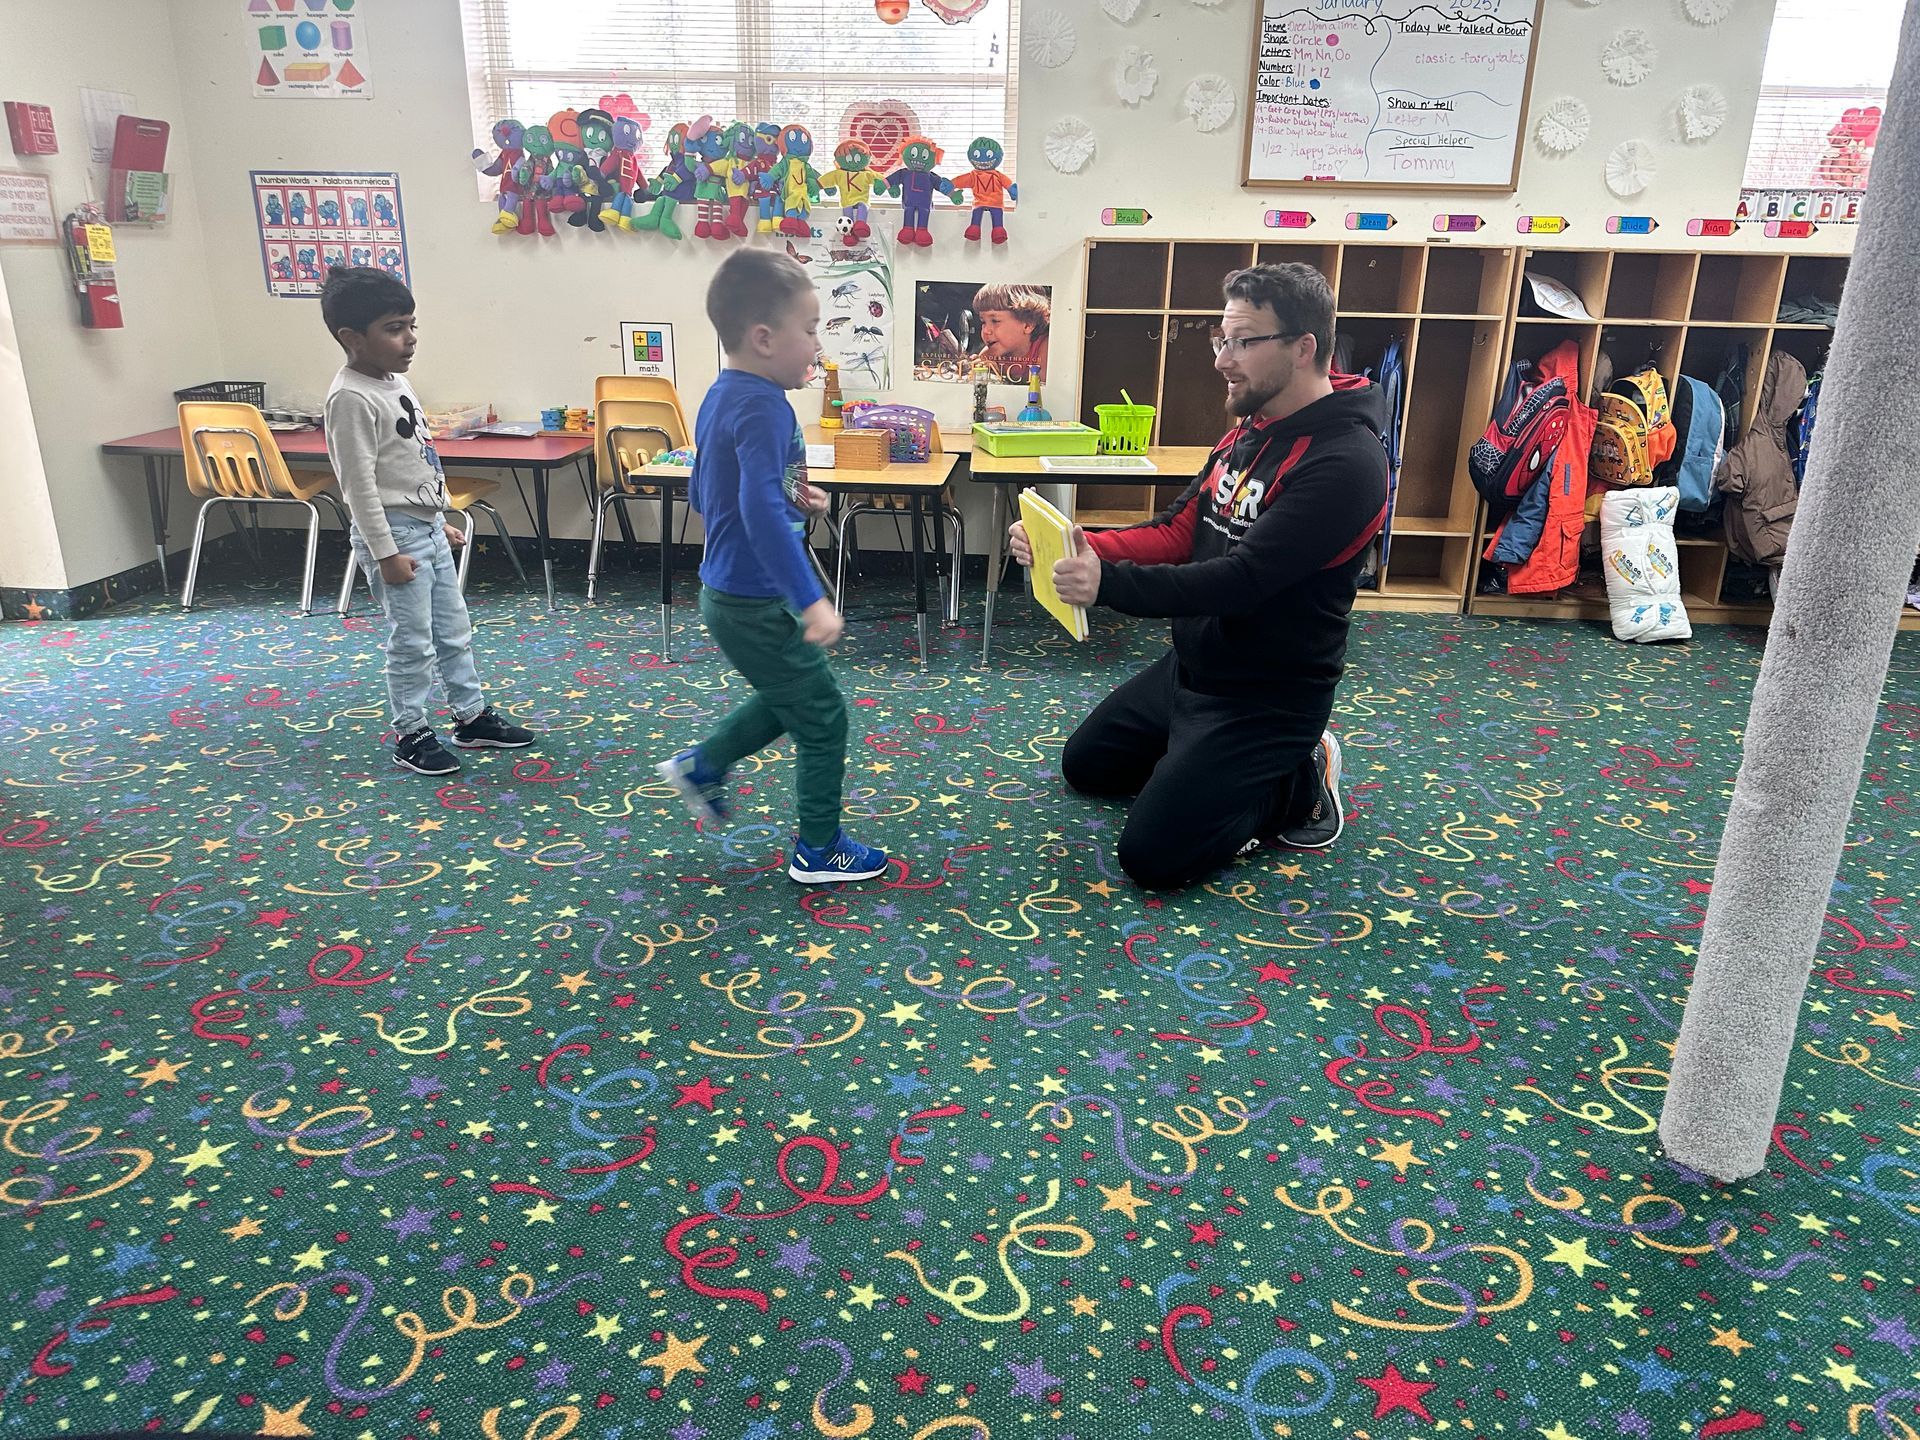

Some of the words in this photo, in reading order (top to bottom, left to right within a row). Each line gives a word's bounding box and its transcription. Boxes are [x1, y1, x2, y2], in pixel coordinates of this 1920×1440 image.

[1399, 21, 1430, 35] Today
[1437, 24, 1451, 32] we
[1457, 22, 1494, 34] talked
[1497, 25, 1528, 36] about
[1292, 34, 1323, 46] Circle
[1415, 53, 1456, 64] classic
[1319, 67, 1331, 79] 12
[1258, 75, 1283, 87] Color:
[1285, 76, 1305, 88] Blue
[1257, 90, 1299, 103] Important
[1387, 97, 1416, 109] Show
[31, 110, 53, 130] FIRE
[1294, 117, 1317, 129] Ducky
[1387, 112, 1426, 126] Letter
[1435, 112, 1450, 126] M
[1395, 135, 1430, 148] Special
[1438, 135, 1469, 148] Helper
[1290, 142, 1324, 160] Happy
[1384, 153, 1455, 178] Tommy
[289, 177, 310, 185] Words
[353, 178, 390, 186] numéricas
[847, 172, 863, 192] K
[911, 173, 924, 192] L
[976, 174, 996, 193] M
[1736, 201, 1748, 217] A
[1767, 202, 1778, 217] B
[1793, 202, 1806, 217] C
[1820, 202, 1833, 218] D
[1846, 203, 1858, 218] E
[1117, 212, 1139, 223] Brady
[1361, 217, 1382, 226] Dean
[1533, 219, 1559, 228] Hudson
[1704, 222, 1724, 232] Kian
[639, 364, 660, 372] math
